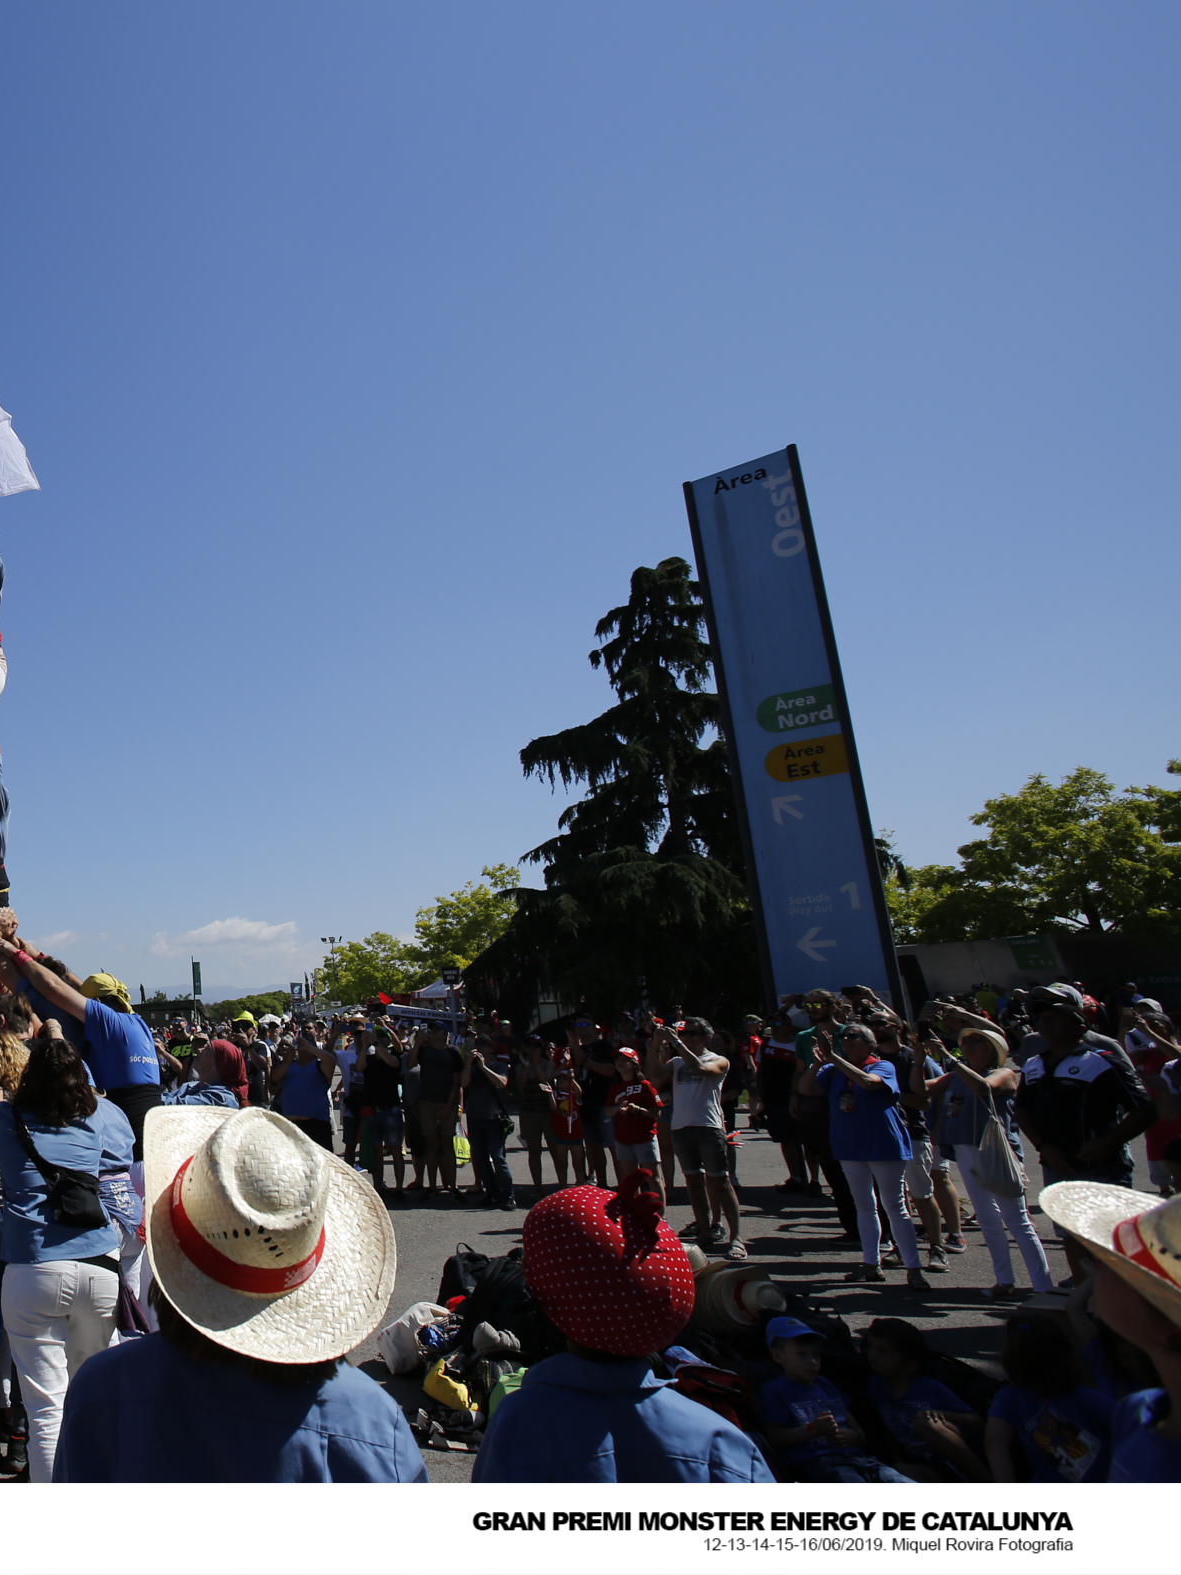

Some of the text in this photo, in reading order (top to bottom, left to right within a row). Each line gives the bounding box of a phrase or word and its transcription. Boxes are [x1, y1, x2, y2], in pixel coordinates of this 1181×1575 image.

[714, 468, 767, 495] Àrea
[761, 468, 807, 558] Oest
[775, 694, 816, 712] Àrea
[777, 704, 834, 729] Nord
[784, 744, 825, 761] Àrea
[786, 760, 822, 779] Est
[789, 894, 831, 906] Sortida
[839, 881, 862, 910] 1
[789, 904, 833, 917] Way out
[130, 1053, 142, 1063] sóc
[171, 1045, 192, 1057] 46
